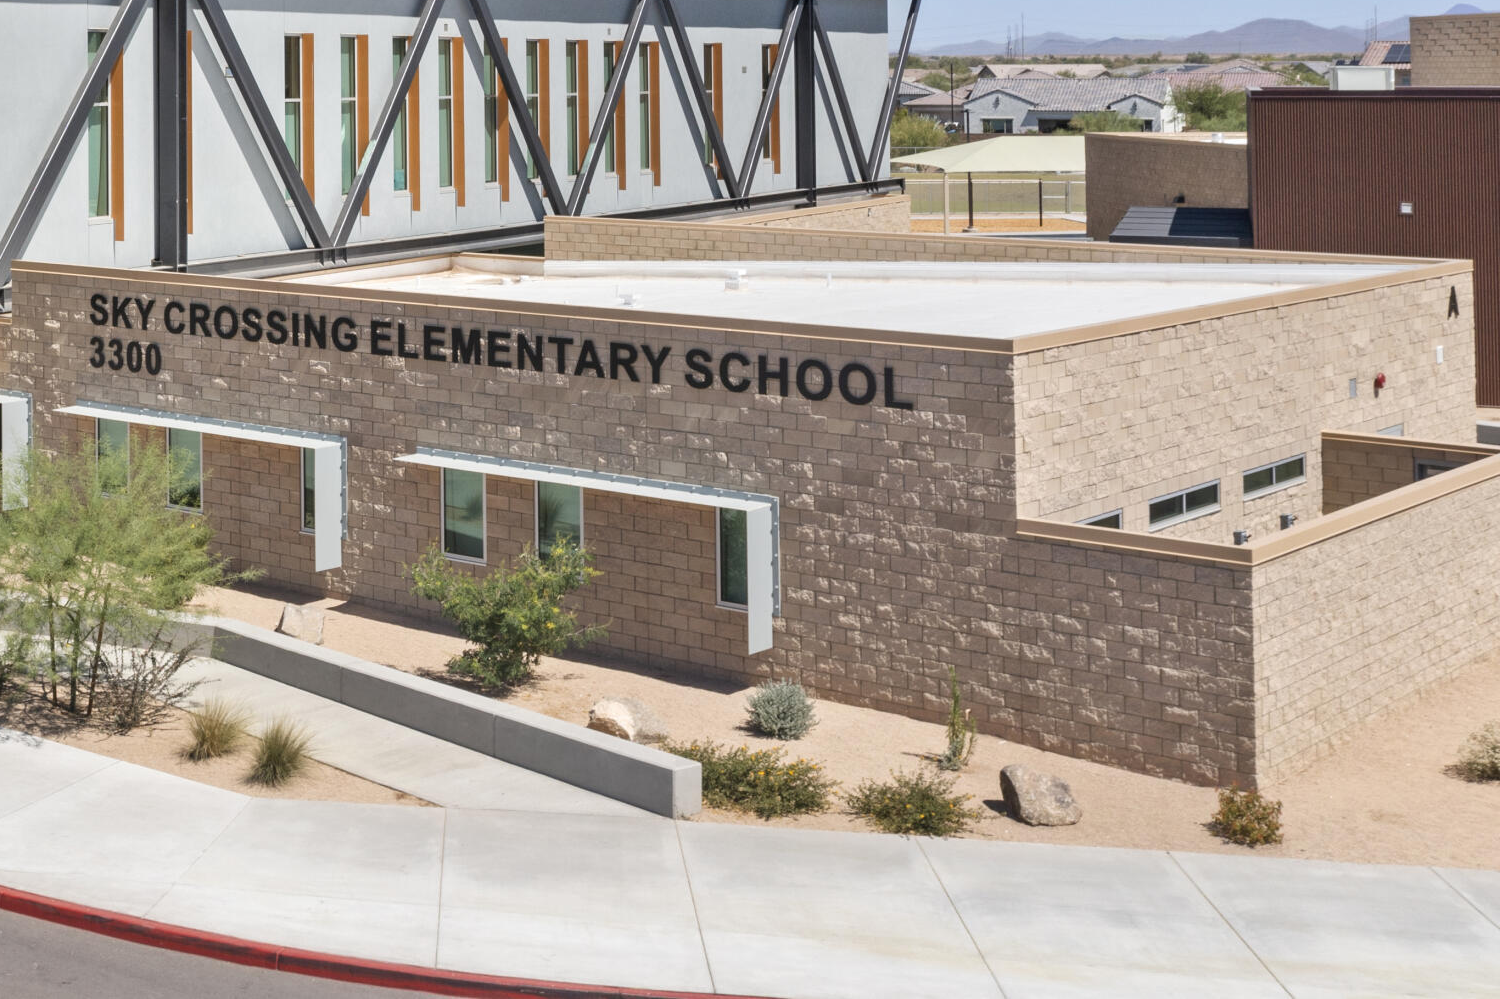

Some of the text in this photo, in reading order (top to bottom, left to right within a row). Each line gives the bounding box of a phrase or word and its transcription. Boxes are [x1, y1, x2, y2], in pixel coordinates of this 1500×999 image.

[1447, 286, 1459, 320] A
[89, 293, 914, 411] SKY CROSSING ELEMENTARY SCHOOL
[89, 336, 162, 375] 3300
